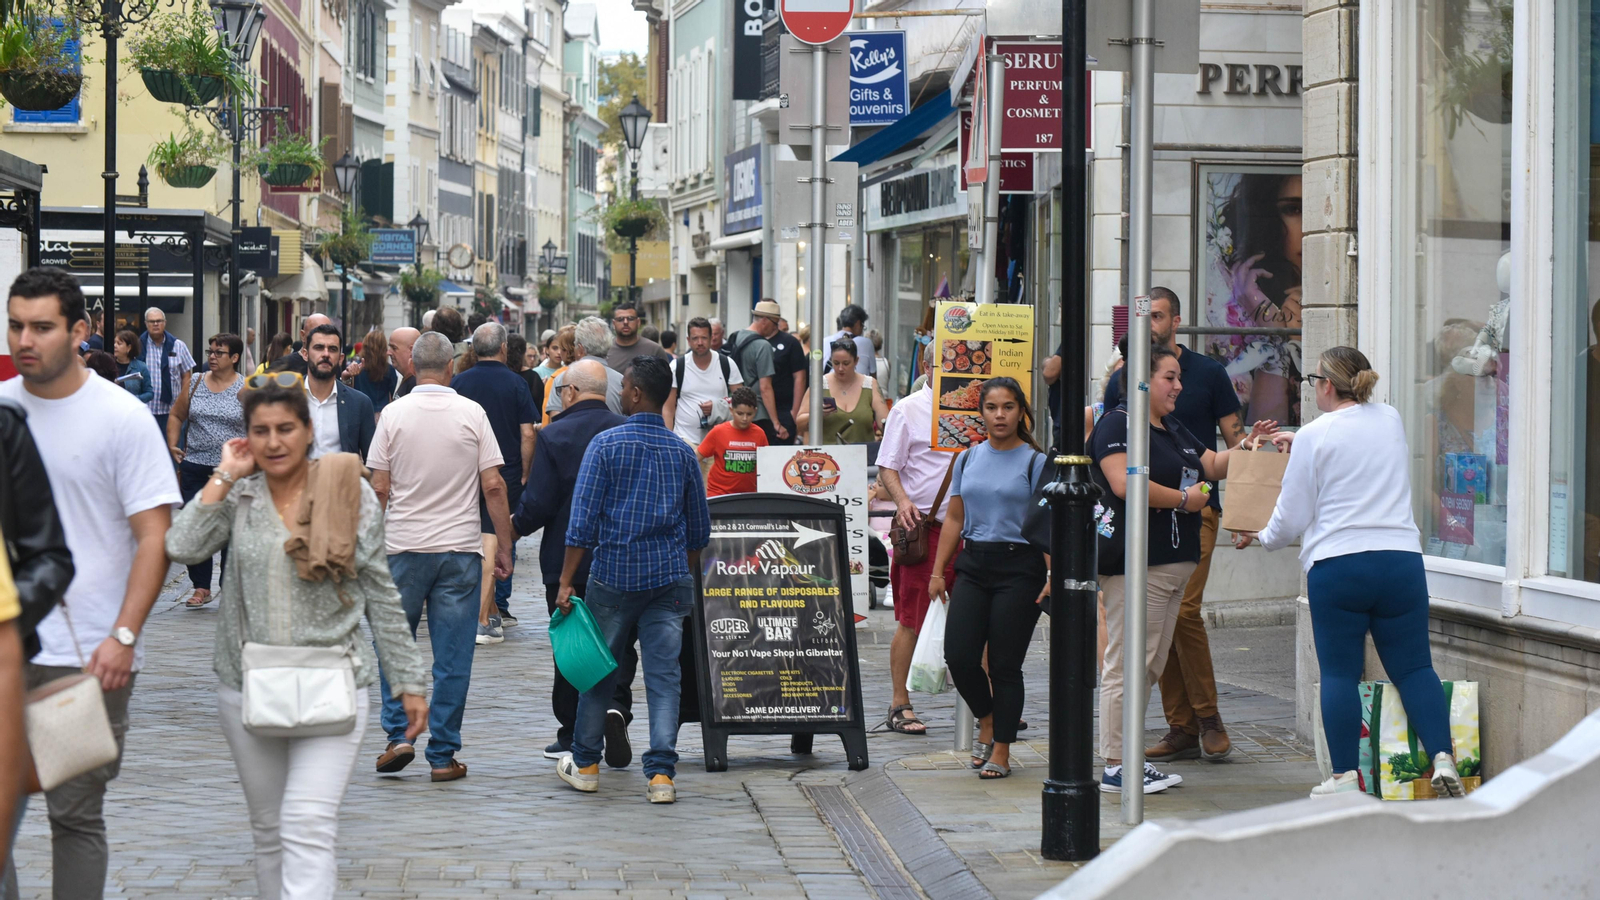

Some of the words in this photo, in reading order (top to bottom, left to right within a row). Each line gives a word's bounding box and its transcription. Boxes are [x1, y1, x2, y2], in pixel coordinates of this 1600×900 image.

[850, 47, 896, 72] Kelly's
[1003, 52, 1063, 69] SERU
[1196, 63, 1304, 95] PERF
[1010, 80, 1063, 91] PERFUM
[850, 88, 880, 102] Gifts
[883, 87, 893, 101] &
[1038, 94, 1050, 105] &
[850, 102, 904, 116] ouvenirs
[1006, 107, 1062, 119] COSMET
[1035, 133, 1054, 144] 187
[372, 242, 413, 250] CORNER
[982, 322, 996, 330] Open
[998, 348, 1024, 358] Indian
[999, 359, 1022, 370] Curry
[727, 523, 732, 531] 2
[732, 523, 737, 531] &
[738, 523, 745, 531] 21
[746, 523, 775, 531] Cornwall's
[775, 523, 790, 531] Lane
[715, 560, 757, 575] Rock
[703, 588, 732, 597] LARGE
[735, 587, 764, 597] RANGE
[766, 587, 778, 596] OF
[781, 587, 840, 596] DISPOSABLES
[739, 599, 758, 609] AND
[760, 599, 806, 609] FLAVOURS
[711, 618, 750, 634] SUPER
[757, 616, 798, 628] ULTIMATE
[765, 627, 792, 641] BAR
[711, 649, 731, 658] Your
[732, 649, 749, 657] No1
[749, 649, 772, 659] Vape
[772, 649, 795, 659] Shop
[796, 649, 804, 657] in
[805, 648, 843, 657] Gibraltar
[745, 706, 768, 715] SAME
[768, 706, 784, 714] DAY
[784, 705, 821, 714] DELIVERY
